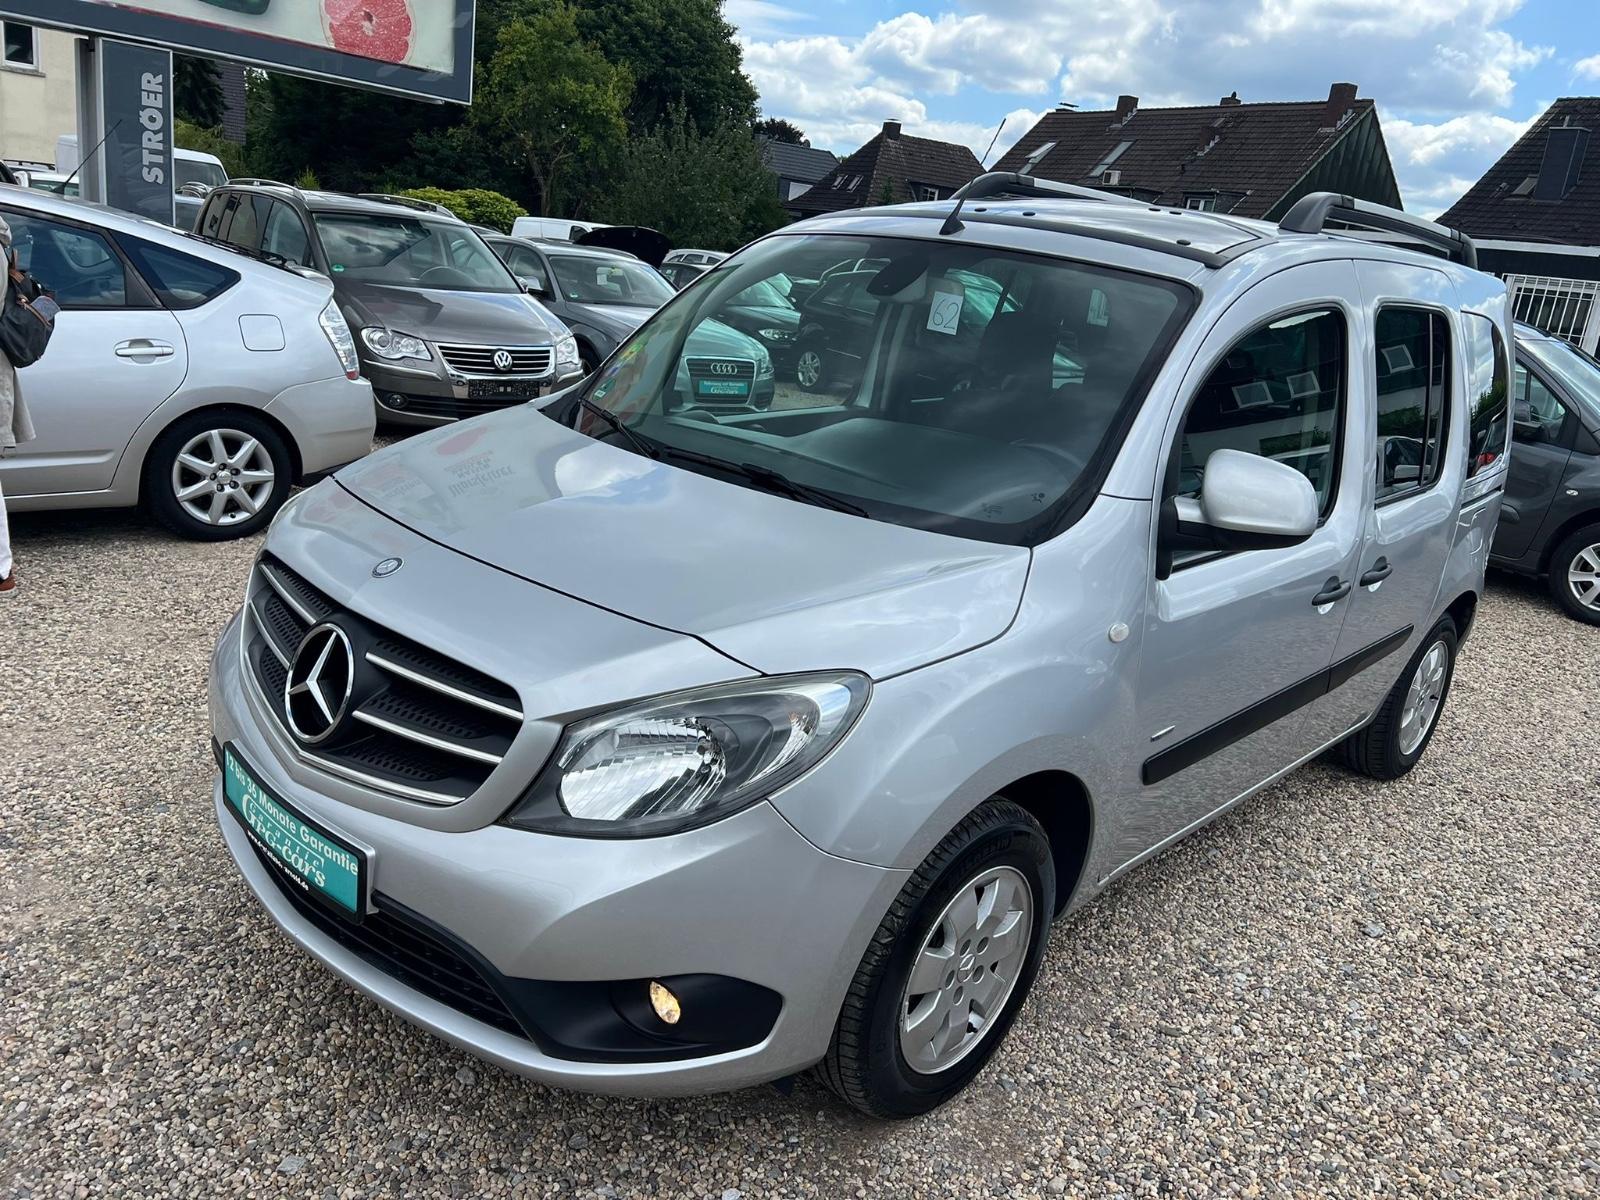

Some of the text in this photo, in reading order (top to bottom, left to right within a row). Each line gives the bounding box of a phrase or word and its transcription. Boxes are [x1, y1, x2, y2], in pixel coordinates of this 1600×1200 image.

[139, 72, 164, 185] STRÖER
[932, 299, 960, 330] 62
[225, 751, 235, 773] 12
[235, 761, 246, 786] bis
[247, 777, 257, 798] 36
[259, 786, 297, 834] Monate
[299, 825, 359, 876] Garantie
